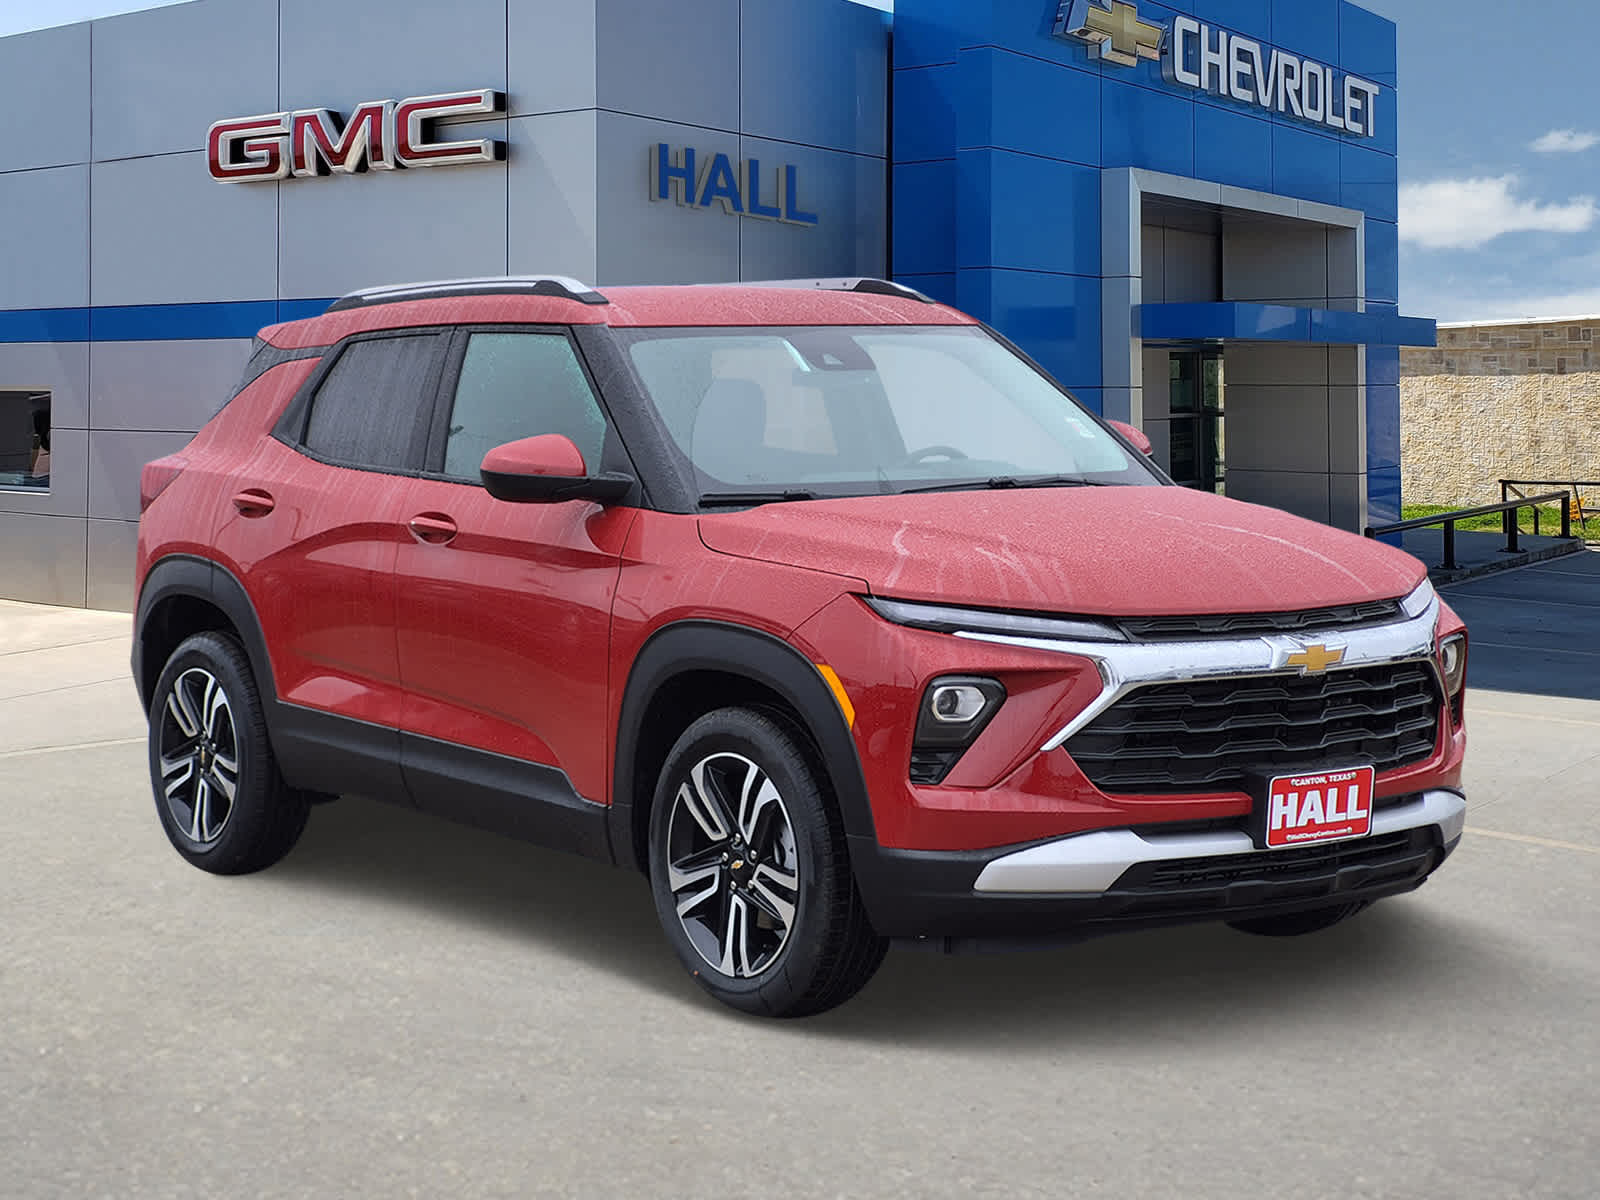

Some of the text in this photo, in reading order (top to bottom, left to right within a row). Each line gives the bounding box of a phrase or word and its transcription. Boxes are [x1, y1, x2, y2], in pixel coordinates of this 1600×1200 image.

[1172, 15, 1380, 137] CHEVROLET
[206, 88, 507, 184] GMC
[651, 143, 818, 227] HALL
[1271, 785, 1368, 830] HALL
[1295, 772, 1353, 787] CANTON, TEXAS
